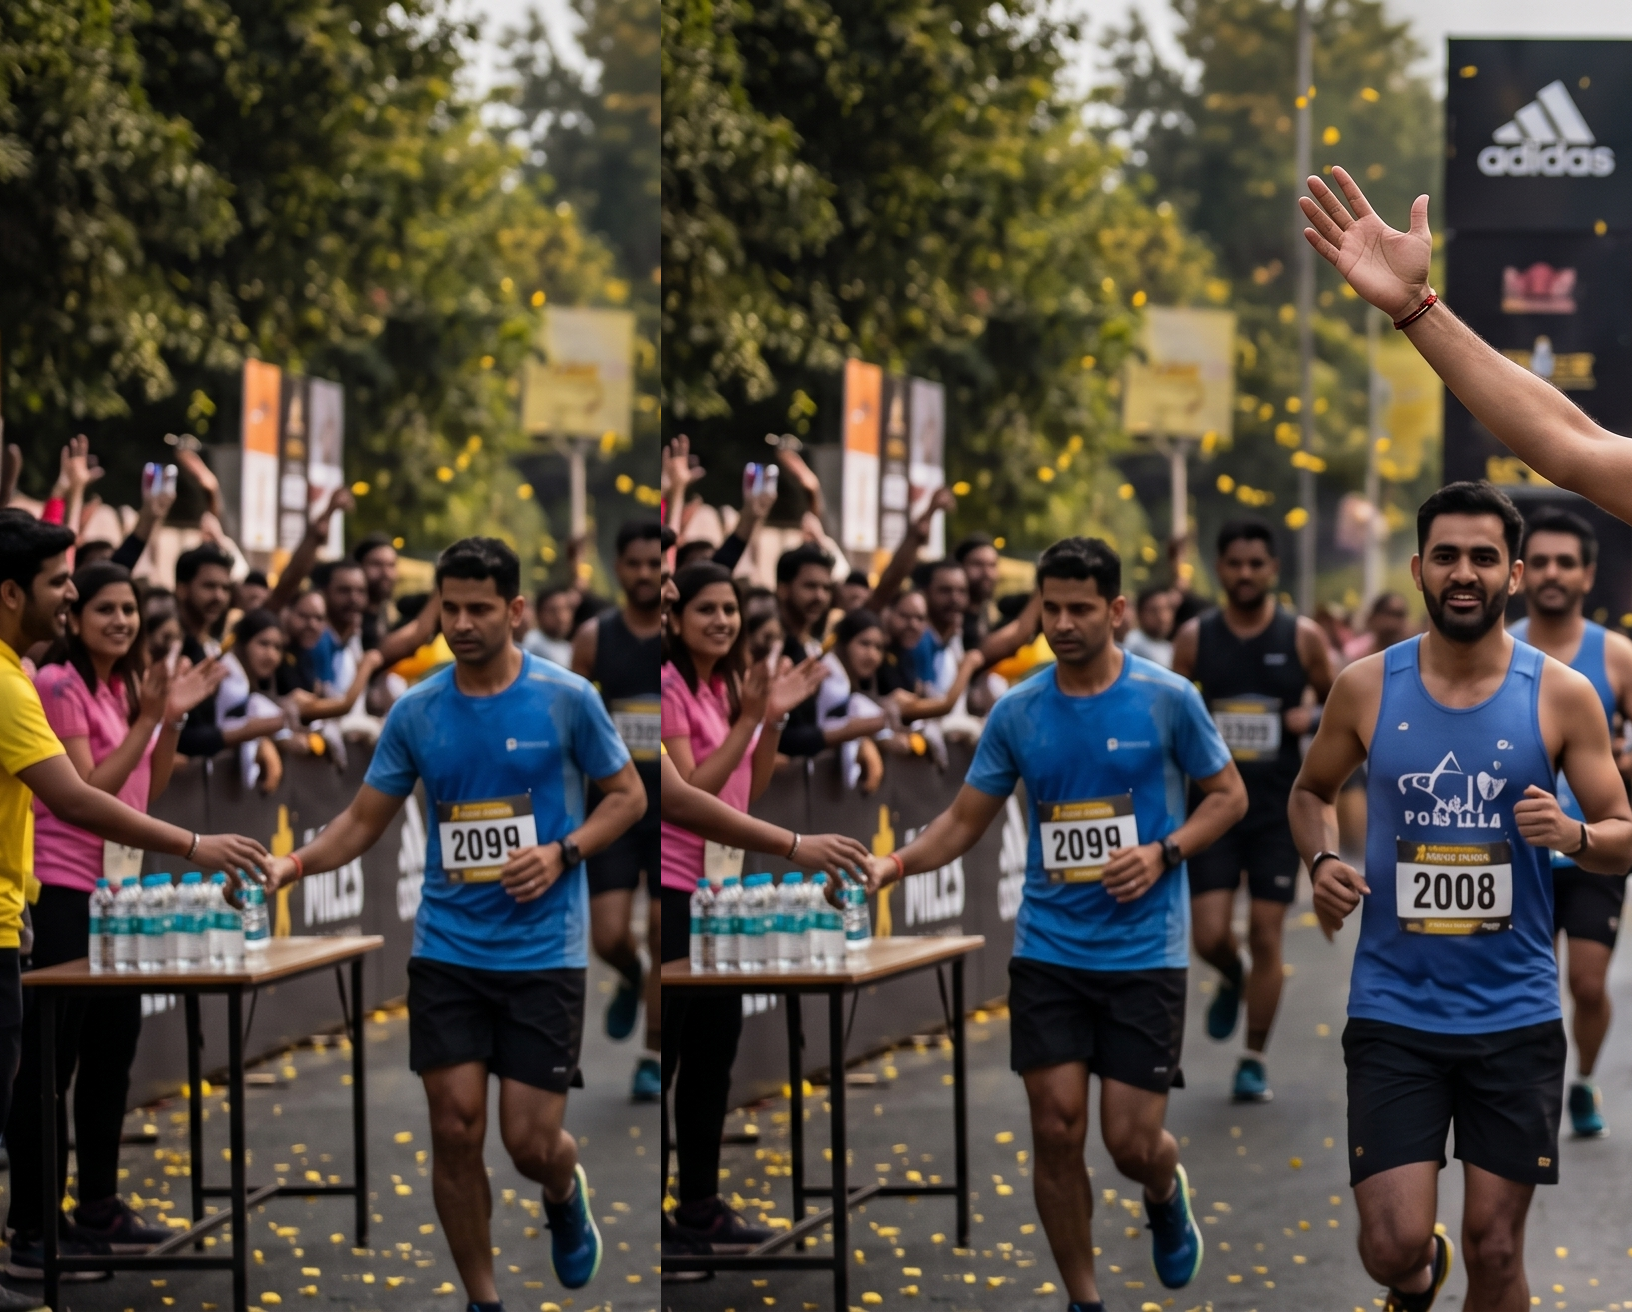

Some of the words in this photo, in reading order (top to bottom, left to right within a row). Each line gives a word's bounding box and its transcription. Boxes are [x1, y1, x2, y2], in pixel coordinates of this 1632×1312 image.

[1477, 138, 1616, 177] adidas
[452, 825, 520, 862] 2099
[1053, 825, 1121, 862] 2099
[1414, 872, 1495, 910] 2008
